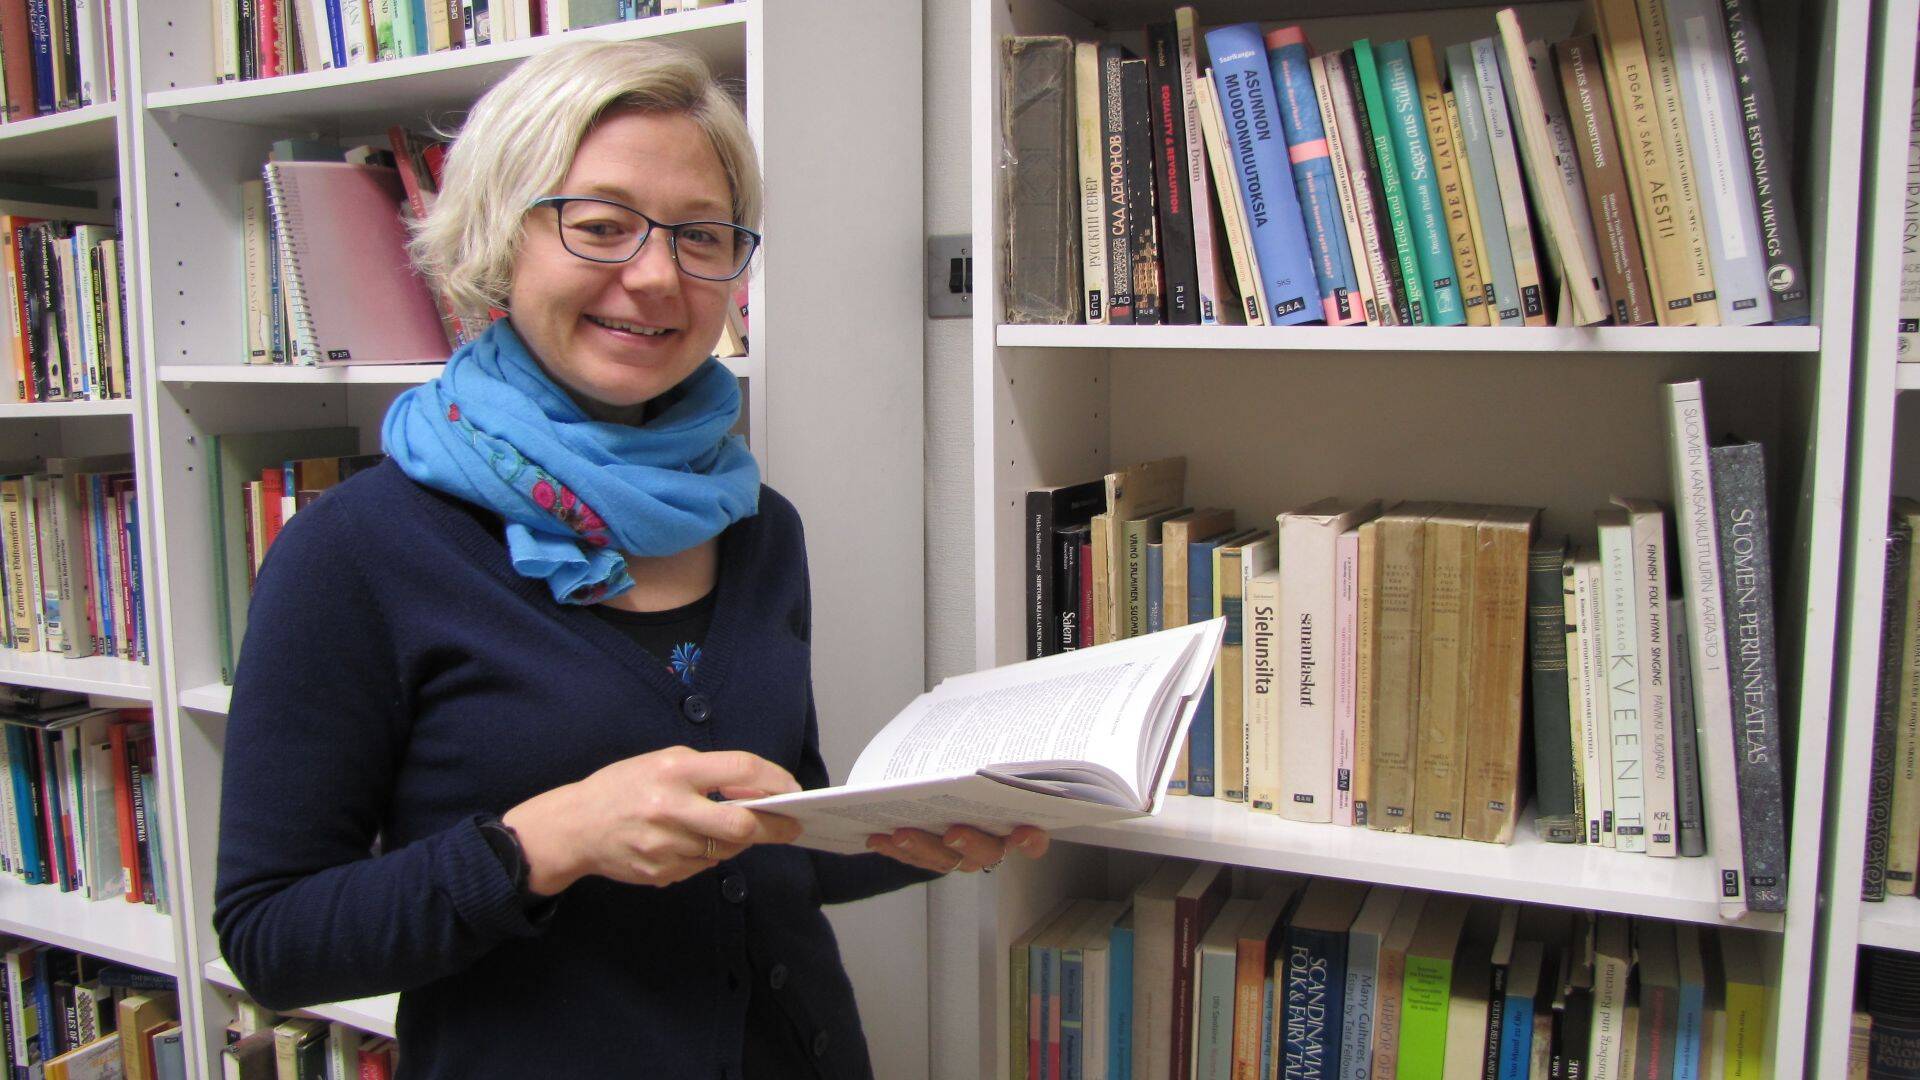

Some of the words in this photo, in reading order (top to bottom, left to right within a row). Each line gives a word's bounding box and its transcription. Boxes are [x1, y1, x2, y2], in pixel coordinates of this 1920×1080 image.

[38, 13, 49, 42] Guide
[1726, 11, 1742, 29] V.
[41, 43, 49, 54] to
[1180, 36, 1192, 58] The
[1729, 29, 1748, 65] SAKS
[1569, 46, 1587, 86] STYLES
[1387, 56, 1412, 113] Südtirol
[1578, 86, 1593, 112] AND
[1159, 85, 1173, 135] EQUALITY
[1185, 98, 1199, 143] Shaman
[1242, 68, 1272, 142] ASUNNON
[1625, 63, 1644, 111] EDGAR
[1638, 130, 1656, 167] SAKS
[1741, 93, 1758, 122] THE
[1164, 136, 1173, 144] &
[1401, 113, 1418, 138] aus
[1424, 91, 1453, 170] LAUSITZ
[1583, 112, 1607, 169] POSITIONS
[1190, 148, 1201, 182] Drum
[1222, 73, 1271, 228] MUODONMUUTOKSIA
[1375, 134, 1398, 193] Spreewald
[1405, 138, 1429, 181] Sagen
[1746, 124, 1771, 195] ESTONIAN
[1107, 135, 1125, 204] ДЕМОНОВ
[1164, 146, 1179, 214] REVOLUTION
[1085, 177, 1099, 212] СЕВЕР
[1387, 193, 1401, 218] und
[1444, 183, 1462, 219] DER
[1111, 208, 1127, 235] САД
[1393, 220, 1409, 253] Heide
[1758, 198, 1781, 258] VIKINGS
[1401, 254, 1412, 274] aus
[1454, 230, 1479, 293] SAGEN
[1090, 294, 1099, 316] RUS
[1175, 285, 1184, 309] RUT
[1277, 300, 1302, 315] SAA
[1337, 289, 1349, 312] SAA
[1682, 407, 1702, 465] SUOMEN
[1688, 468, 1714, 593] KANSANKULTTUURIN
[1645, 543, 1657, 581] FINNISH
[1729, 507, 1758, 603] SUOMEN
[1129, 562, 1138, 603] SALMINEN,
[1648, 585, 1659, 607] FOLK
[1062, 611, 1075, 643] Salem
[1649, 613, 1660, 642] HYMN
[1700, 596, 1719, 658] KARTASTO
[1254, 606, 1273, 694] Sielunsilta
[1297, 613, 1316, 707] sananlaskut
[1649, 646, 1663, 686] SINGING
[1737, 611, 1768, 764] PERINNEATLAS
[1609, 653, 1644, 826] KVEENIT
[1652, 733, 1666, 779] SUOJANEN
[1338, 769, 1347, 787] SAN
[134, 805, 146, 842] CHRISTMAS
[1355, 802, 1363, 823] SAL
[1653, 811, 1670, 820] KPL
[1289, 945, 1310, 990] FOLK
[1599, 962, 1616, 1008] Ravenna
[1288, 990, 1306, 1001] &
[1359, 974, 1372, 1009] Many
[66, 1006, 75, 1028] TALES
[1286, 1005, 1305, 1047] FAIRY
[1303, 955, 1326, 1080] SCANDINAVIA
[1344, 1004, 1355, 1016] by
[1597, 1011, 1610, 1032] und
[69, 1030, 77, 1041] OF
[1343, 1019, 1353, 1040] Tata
[1284, 1051, 1302, 1080] TAL
